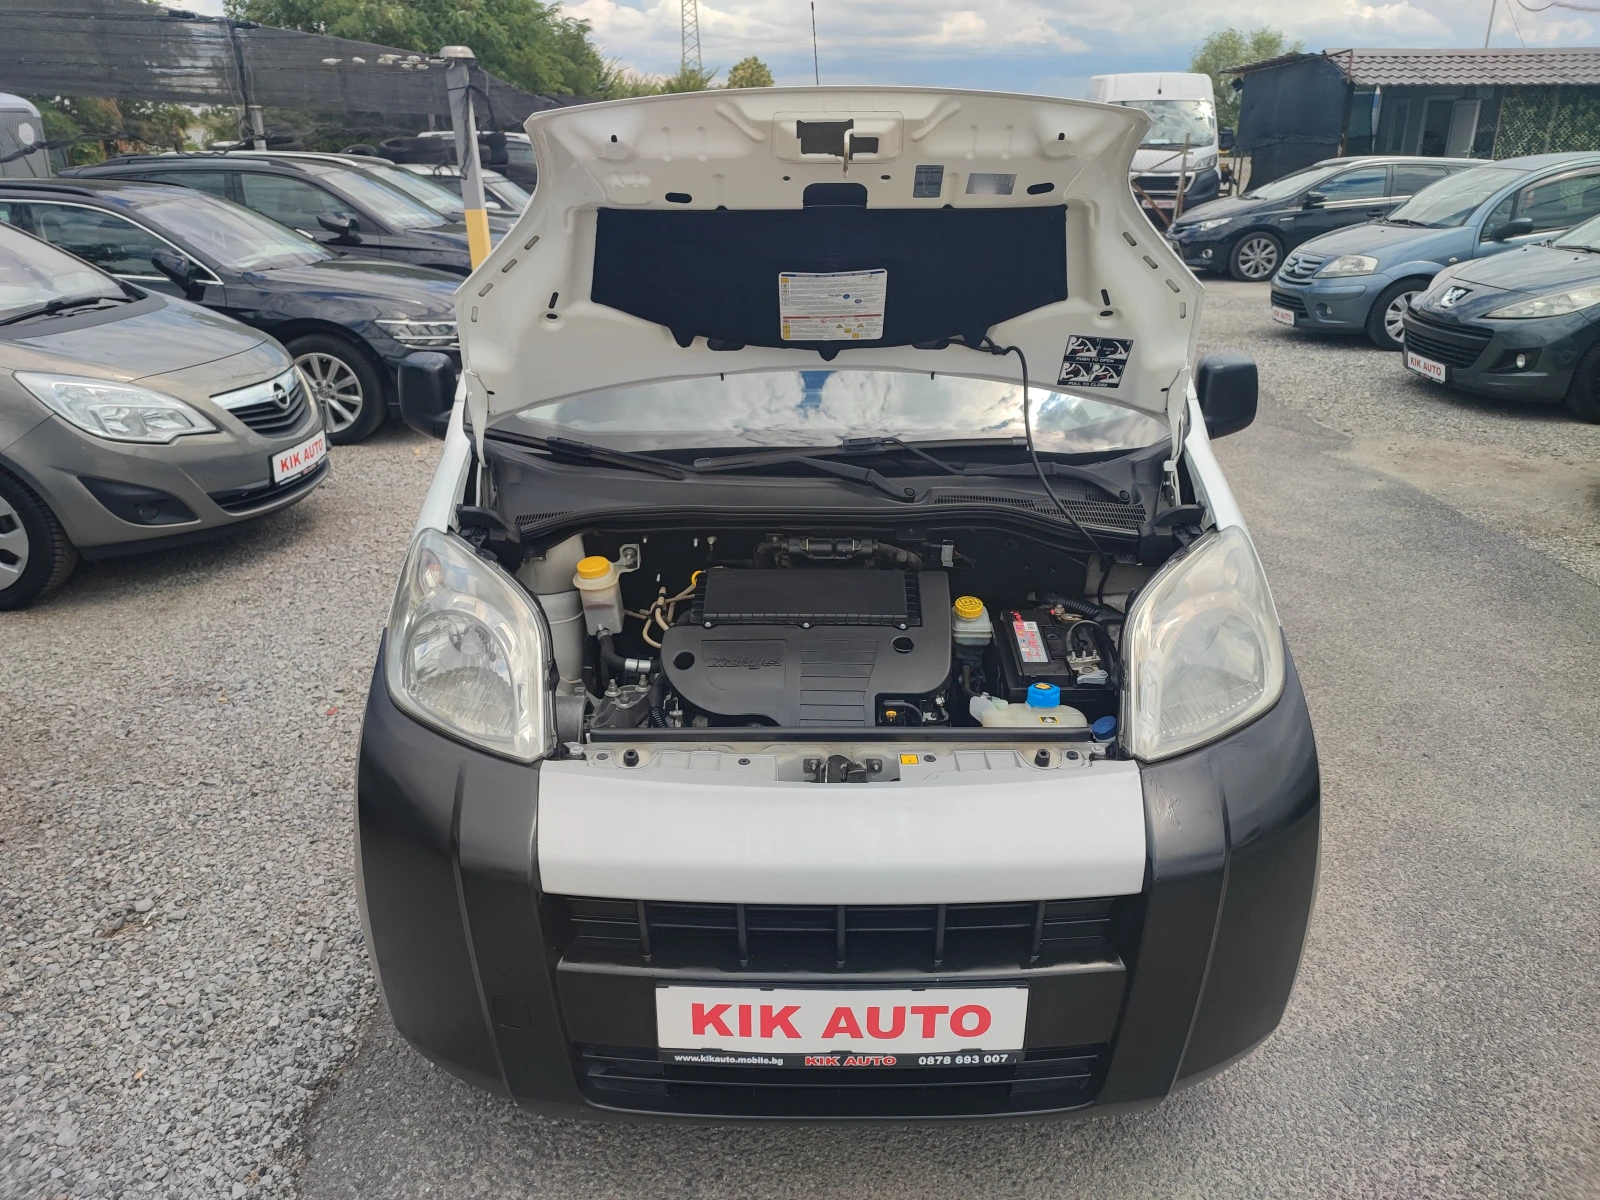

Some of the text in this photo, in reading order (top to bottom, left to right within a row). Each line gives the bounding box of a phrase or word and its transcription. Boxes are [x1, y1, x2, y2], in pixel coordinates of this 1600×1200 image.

[1410, 356, 1442, 376] KIK AUTO
[280, 452, 301, 473] KIK
[304, 438, 323, 462] AUTO
[691, 1003, 992, 1039] KIK AUTO
[674, 1054, 784, 1066] www.kikauto.mobile.bg
[804, 1055, 897, 1066] KIK AUTO
[918, 1054, 1009, 1066] 0878 693 007
